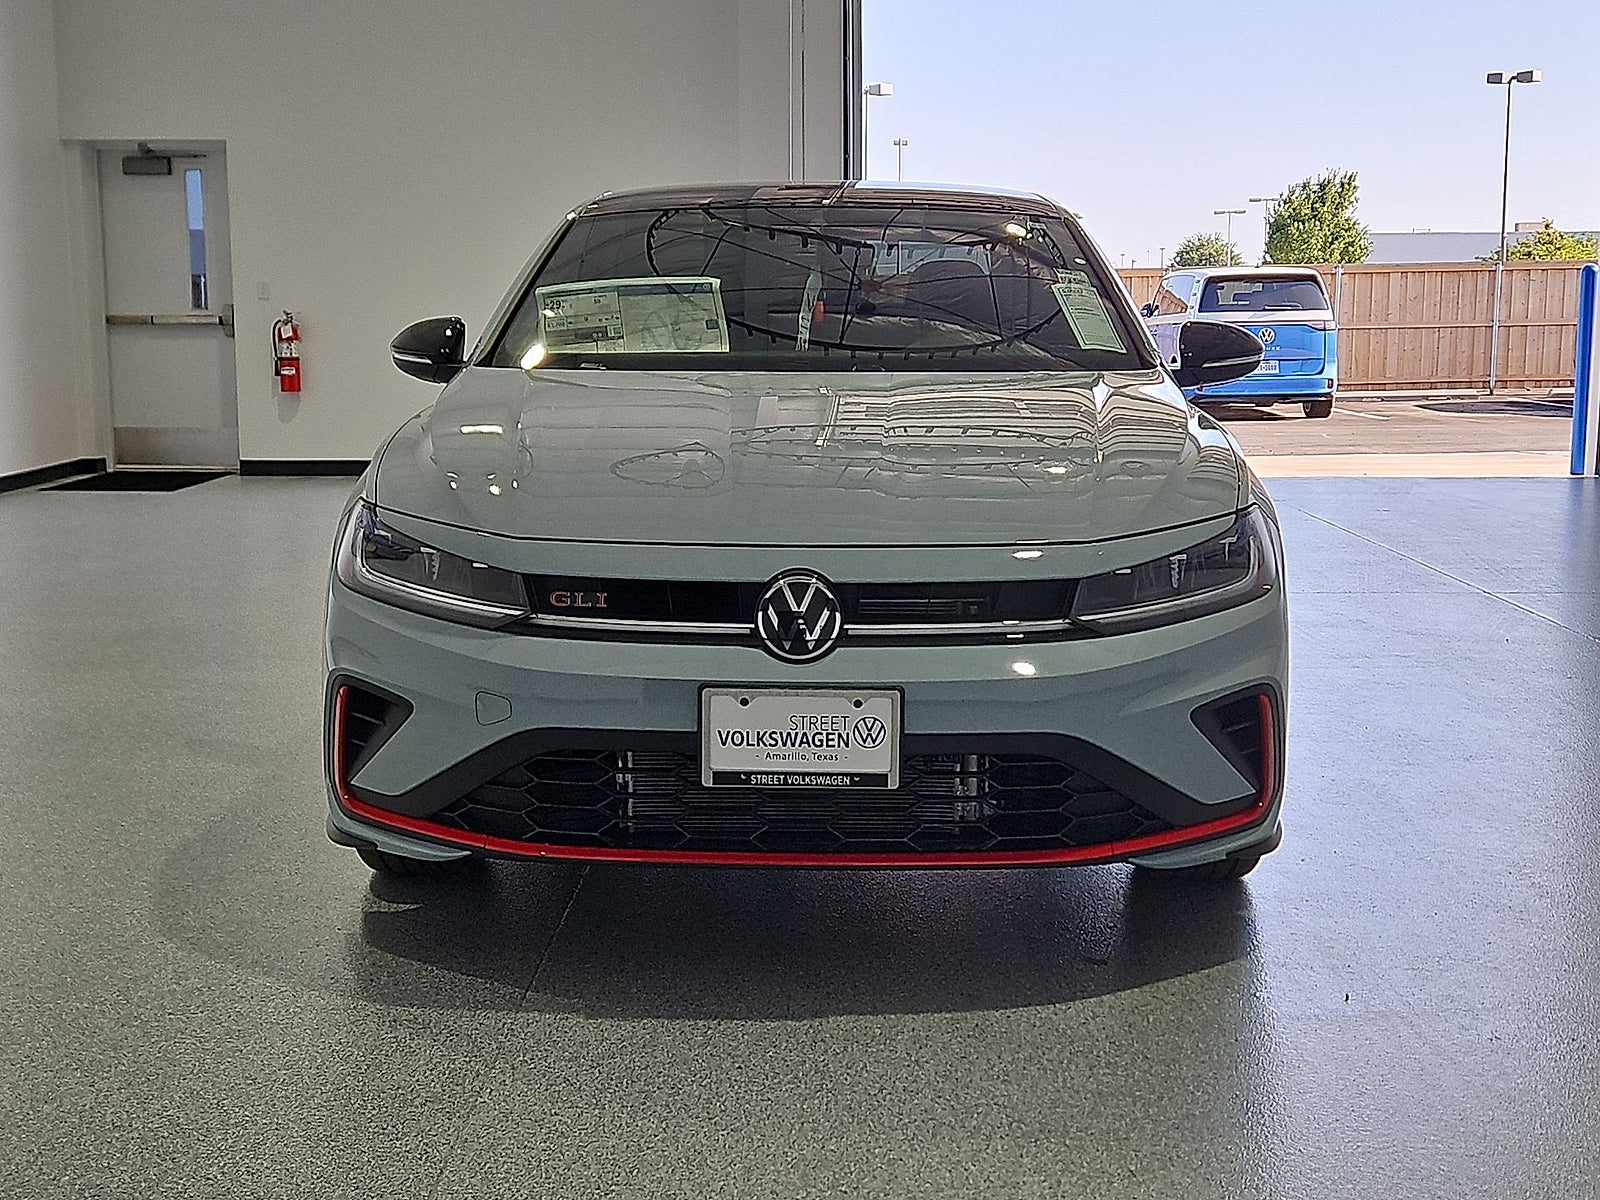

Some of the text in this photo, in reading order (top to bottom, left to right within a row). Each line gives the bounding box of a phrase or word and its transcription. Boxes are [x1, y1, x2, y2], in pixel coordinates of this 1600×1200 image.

[549, 300, 562, 310] 29
[549, 591, 608, 607] GLI
[789, 715, 850, 731] STREET
[717, 730, 850, 748] VOLKSWAGEN
[765, 752, 839, 762] Amarillo, Texas
[750, 775, 850, 786] STREET VOLKSWAGEN
